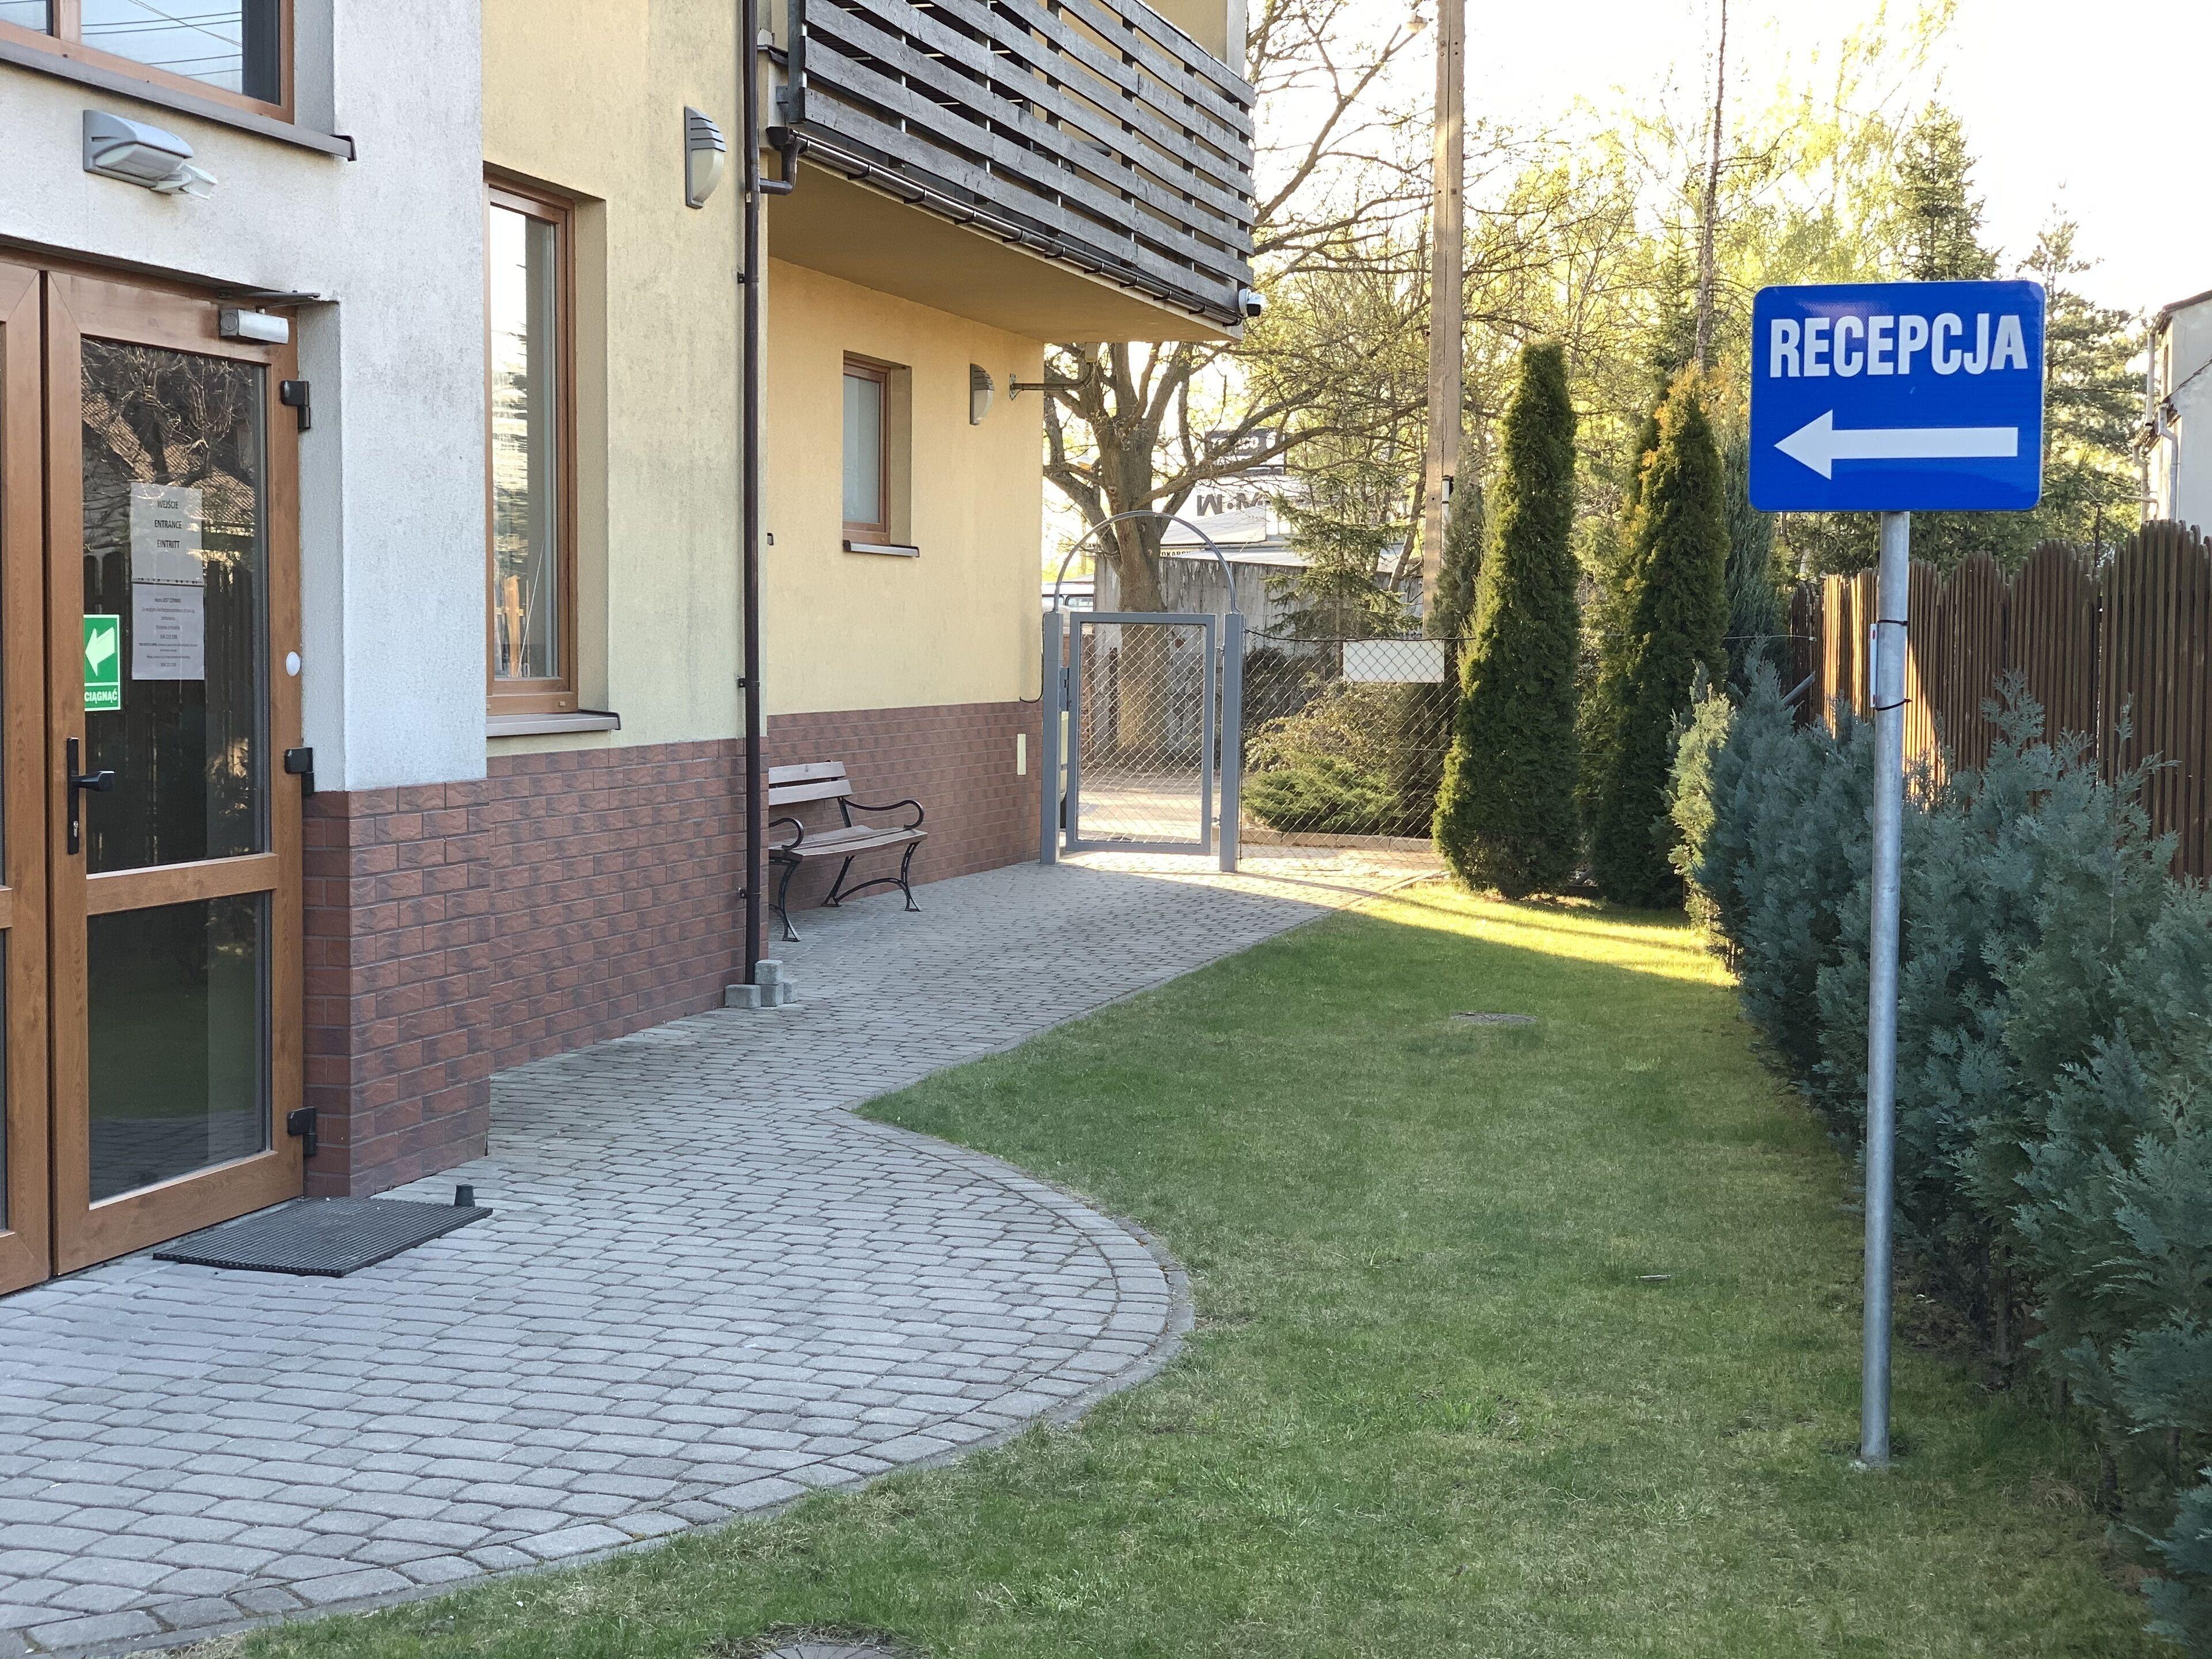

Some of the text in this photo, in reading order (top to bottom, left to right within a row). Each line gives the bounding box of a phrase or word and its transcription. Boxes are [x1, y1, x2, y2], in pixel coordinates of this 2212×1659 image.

[1770, 313, 2028, 378] RECEPCJA
[157, 499, 178, 509] WEJŚCIE
[154, 520, 182, 529] ENTRANCE
[157, 539, 180, 548] EINTRITT
[84, 688, 118, 704] CIĄGNĄĆ
